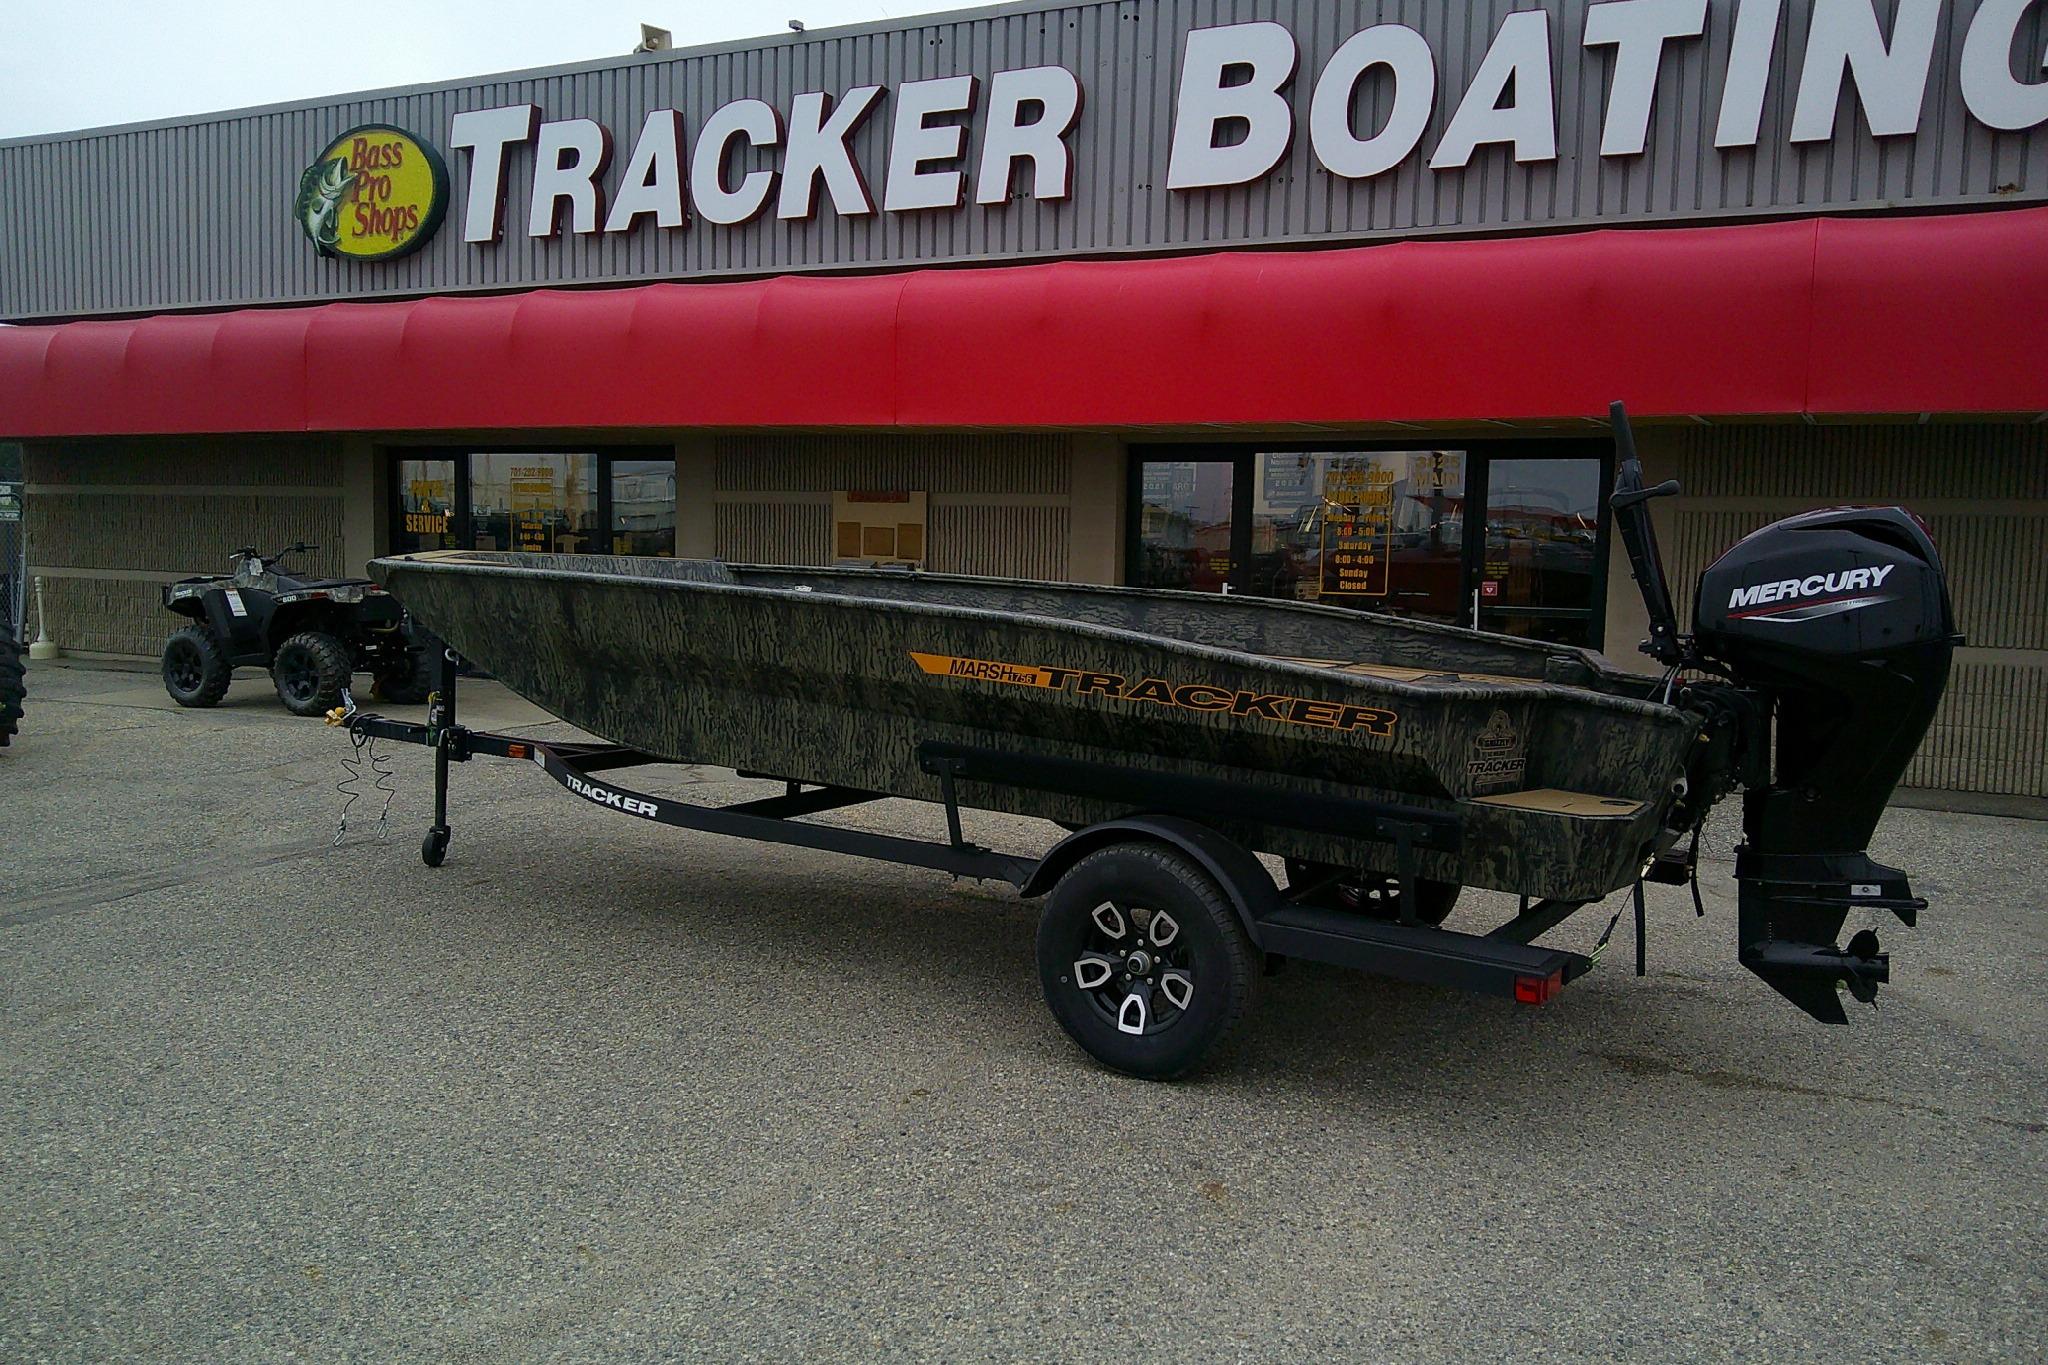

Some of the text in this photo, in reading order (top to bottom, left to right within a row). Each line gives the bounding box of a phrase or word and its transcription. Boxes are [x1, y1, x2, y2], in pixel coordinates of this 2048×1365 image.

[450, 0, 2048, 242] TRACKER BOATING
[349, 138, 403, 171] Bass
[352, 170, 391, 203] Pro
[352, 202, 418, 241] Shops
[405, 513, 449, 534] SERVICE
[1335, 554, 1351, 564] 8:00
[1357, 555, 1374, 564] 4:00
[1338, 541, 1372, 551] Saturday
[1339, 568, 1368, 579] Sunday
[1340, 580, 1367, 590] Closed
[1728, 564, 1895, 608] MERCURY
[949, 659, 1398, 736] MARSH 1756 TRACKER
[1467, 758, 1526, 775] TRACKER
[566, 774, 658, 817] TRACKER
